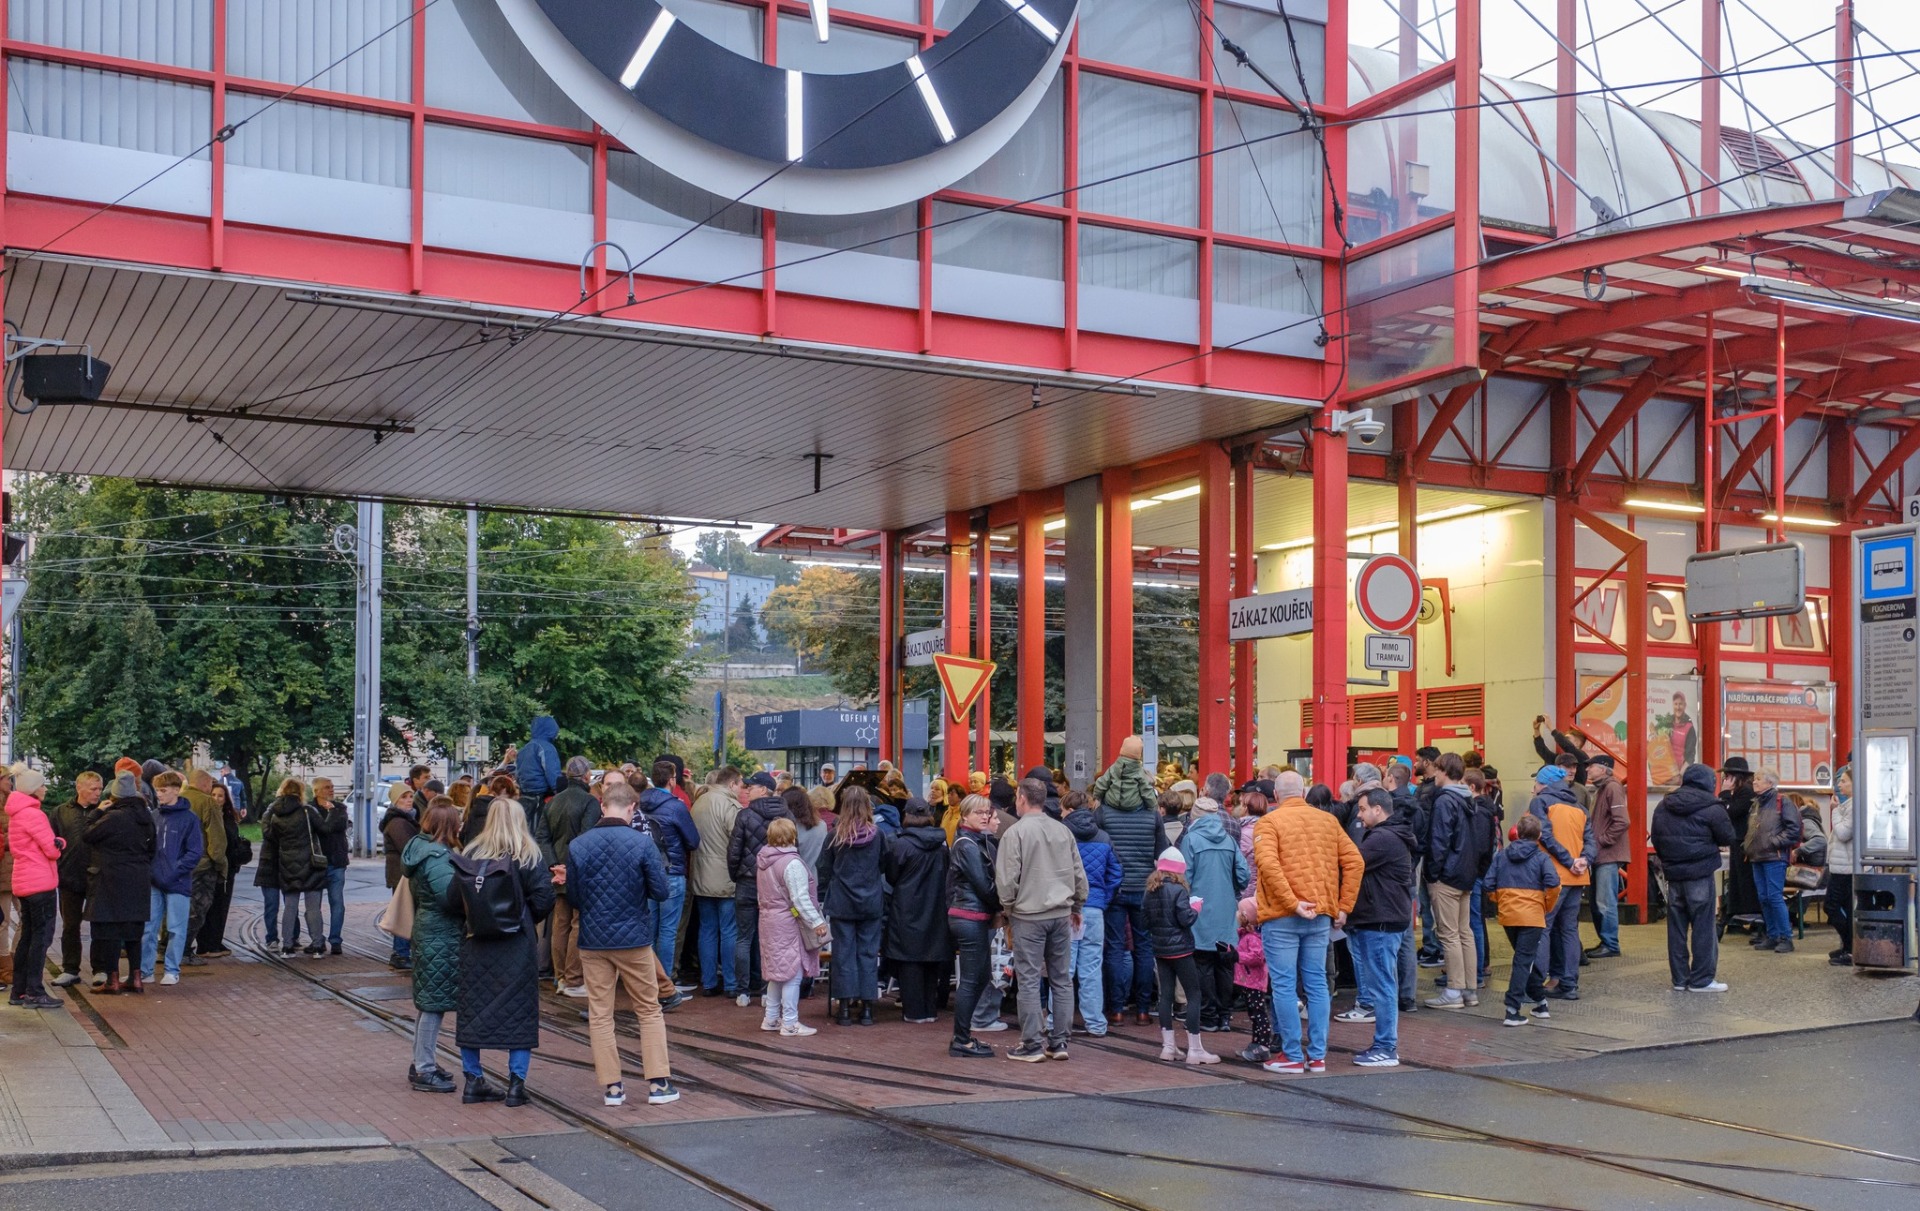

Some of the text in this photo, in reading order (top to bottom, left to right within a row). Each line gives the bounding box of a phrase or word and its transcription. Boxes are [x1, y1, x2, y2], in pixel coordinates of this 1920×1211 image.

[1910, 500, 1919, 517] 6
[1231, 598, 1313, 629] ZÁKAZ KOUŘEN
[1906, 630, 1912, 639] 6
[922, 636, 946, 655] KOUŘE
[1381, 642, 1399, 651] MIMO
[1375, 652, 1404, 662] TRAMVAJ
[1728, 694, 1802, 705] NABÍDKA PRÁCE PRO VÁS
[840, 714, 880, 723] KOFEIN PL
